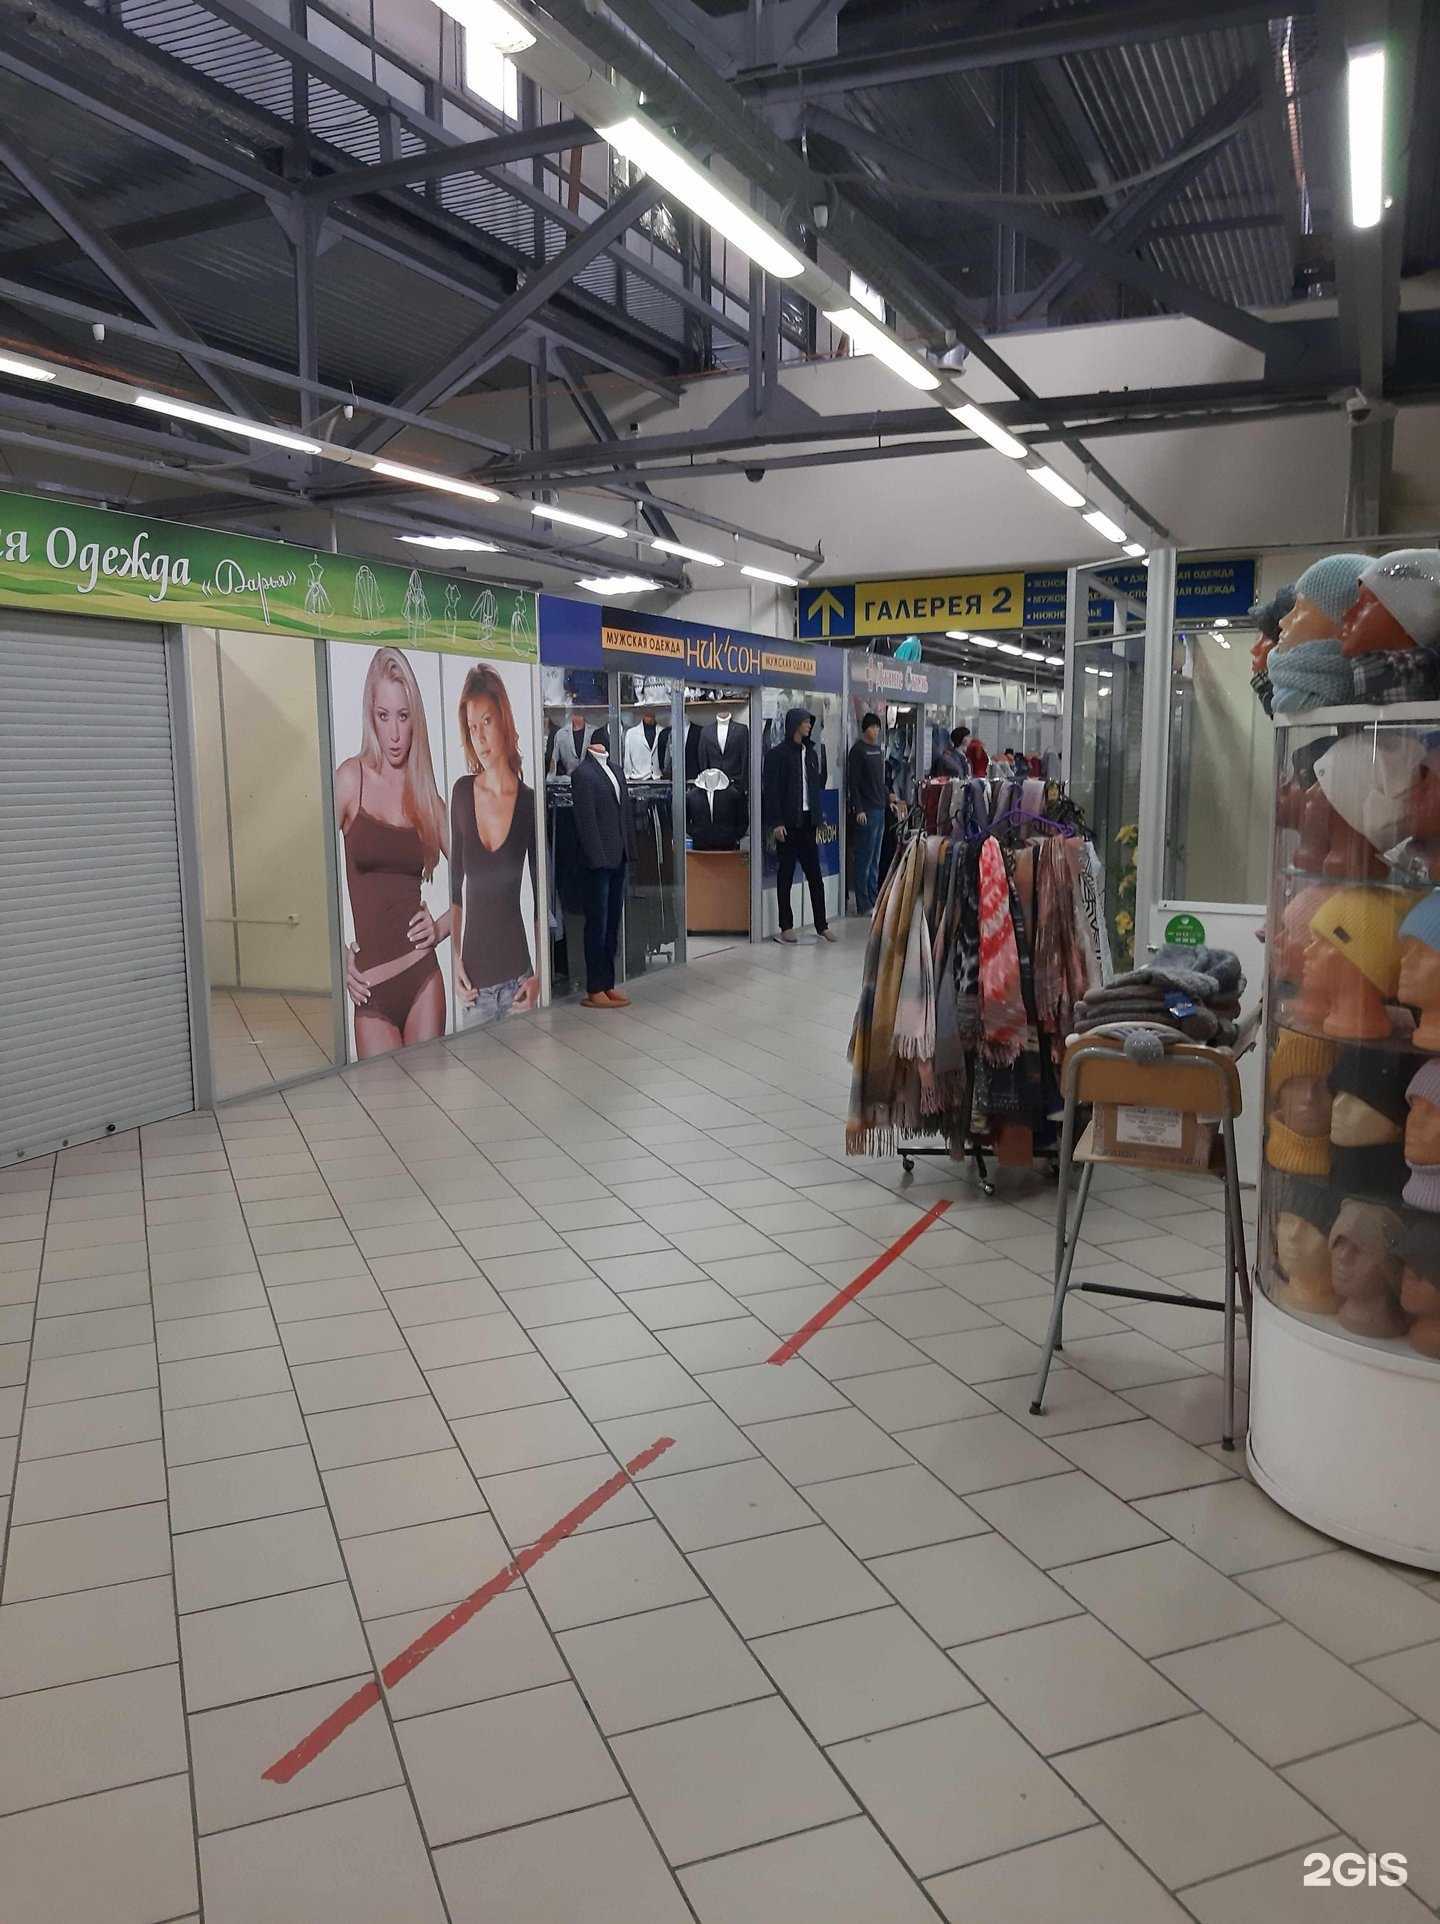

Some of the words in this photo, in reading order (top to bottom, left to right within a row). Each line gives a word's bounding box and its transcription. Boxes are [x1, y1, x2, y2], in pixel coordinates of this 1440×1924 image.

[0, 529, 31, 563] я
[46, 527, 192, 602] Одежда
[865, 594, 981, 622] ГАЛЕРЕЯ
[991, 586, 1012, 614] 2
[606, 631, 648, 649] МУЖСКАЯ
[649, 638, 681, 653] ОДЕЖДА
